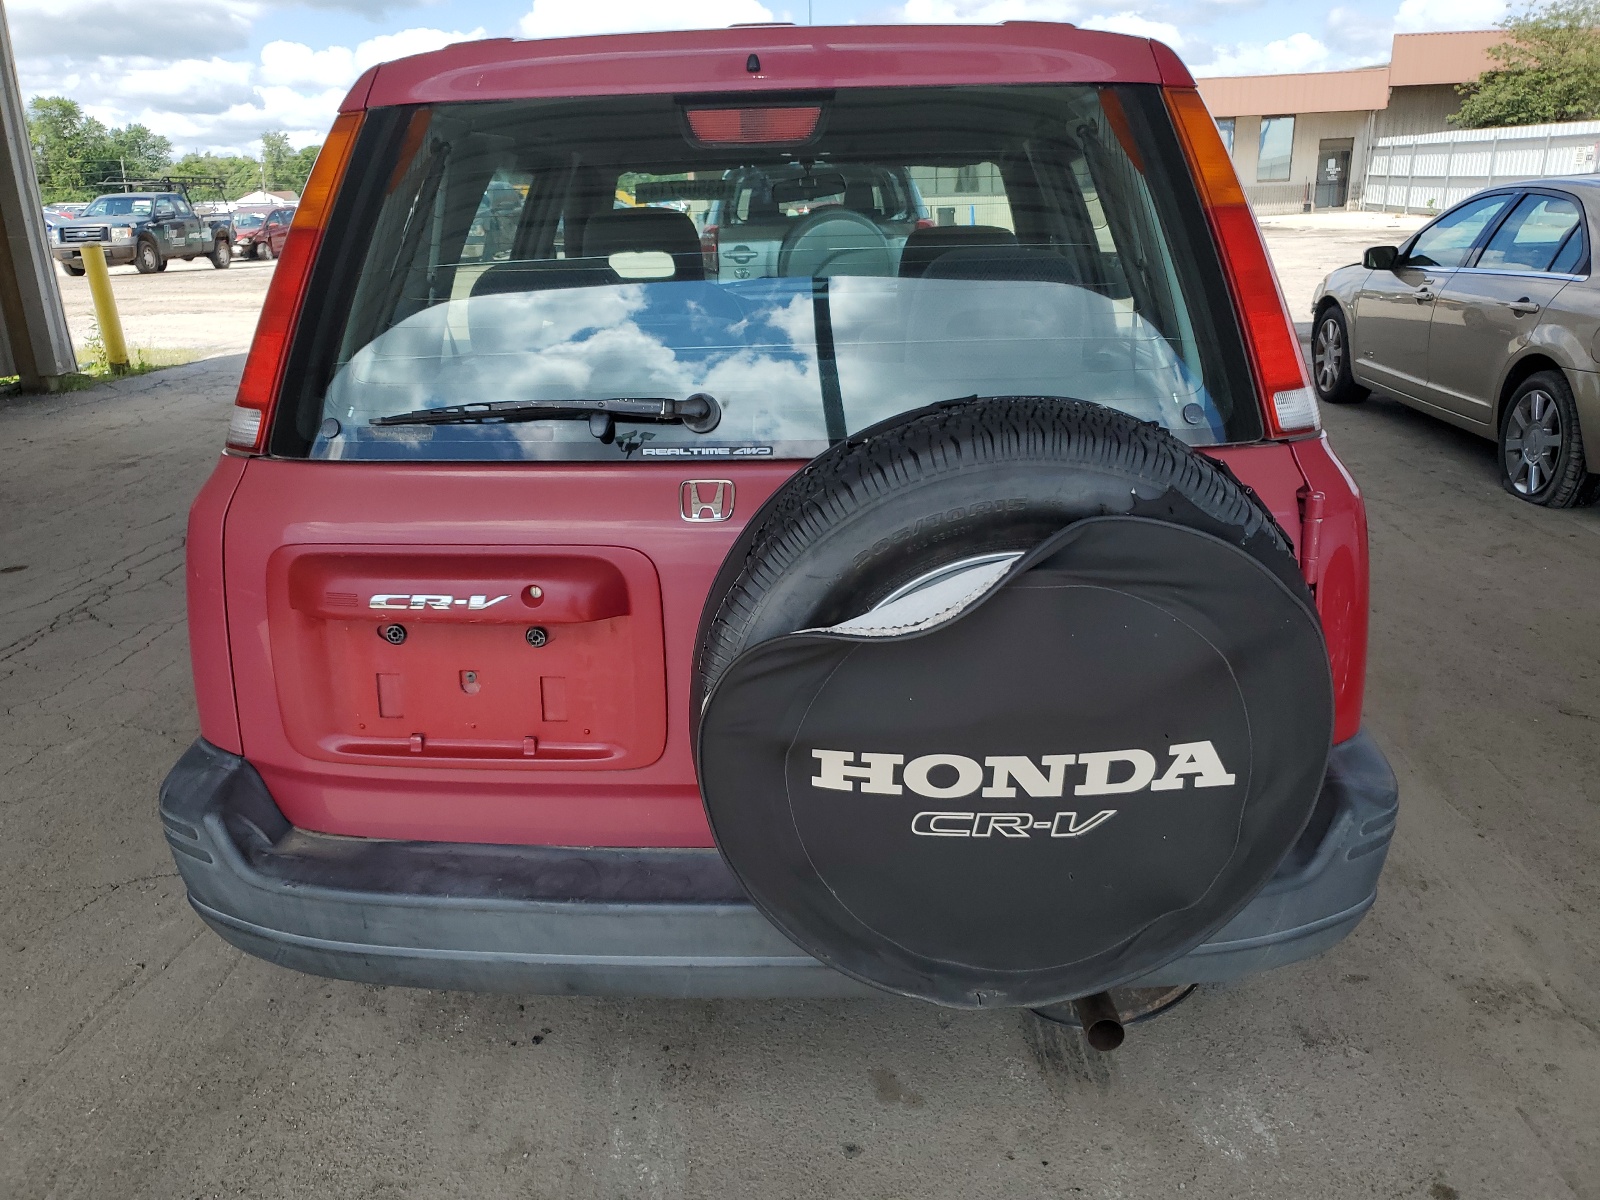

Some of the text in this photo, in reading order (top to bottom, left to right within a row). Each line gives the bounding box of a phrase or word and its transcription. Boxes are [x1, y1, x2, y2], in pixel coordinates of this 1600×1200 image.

[642, 447, 771, 456] REALTIME 4WD
[369, 594, 512, 610] CR-V
[812, 740, 1236, 799] HONDA
[911, 809, 1118, 838] CR-V
